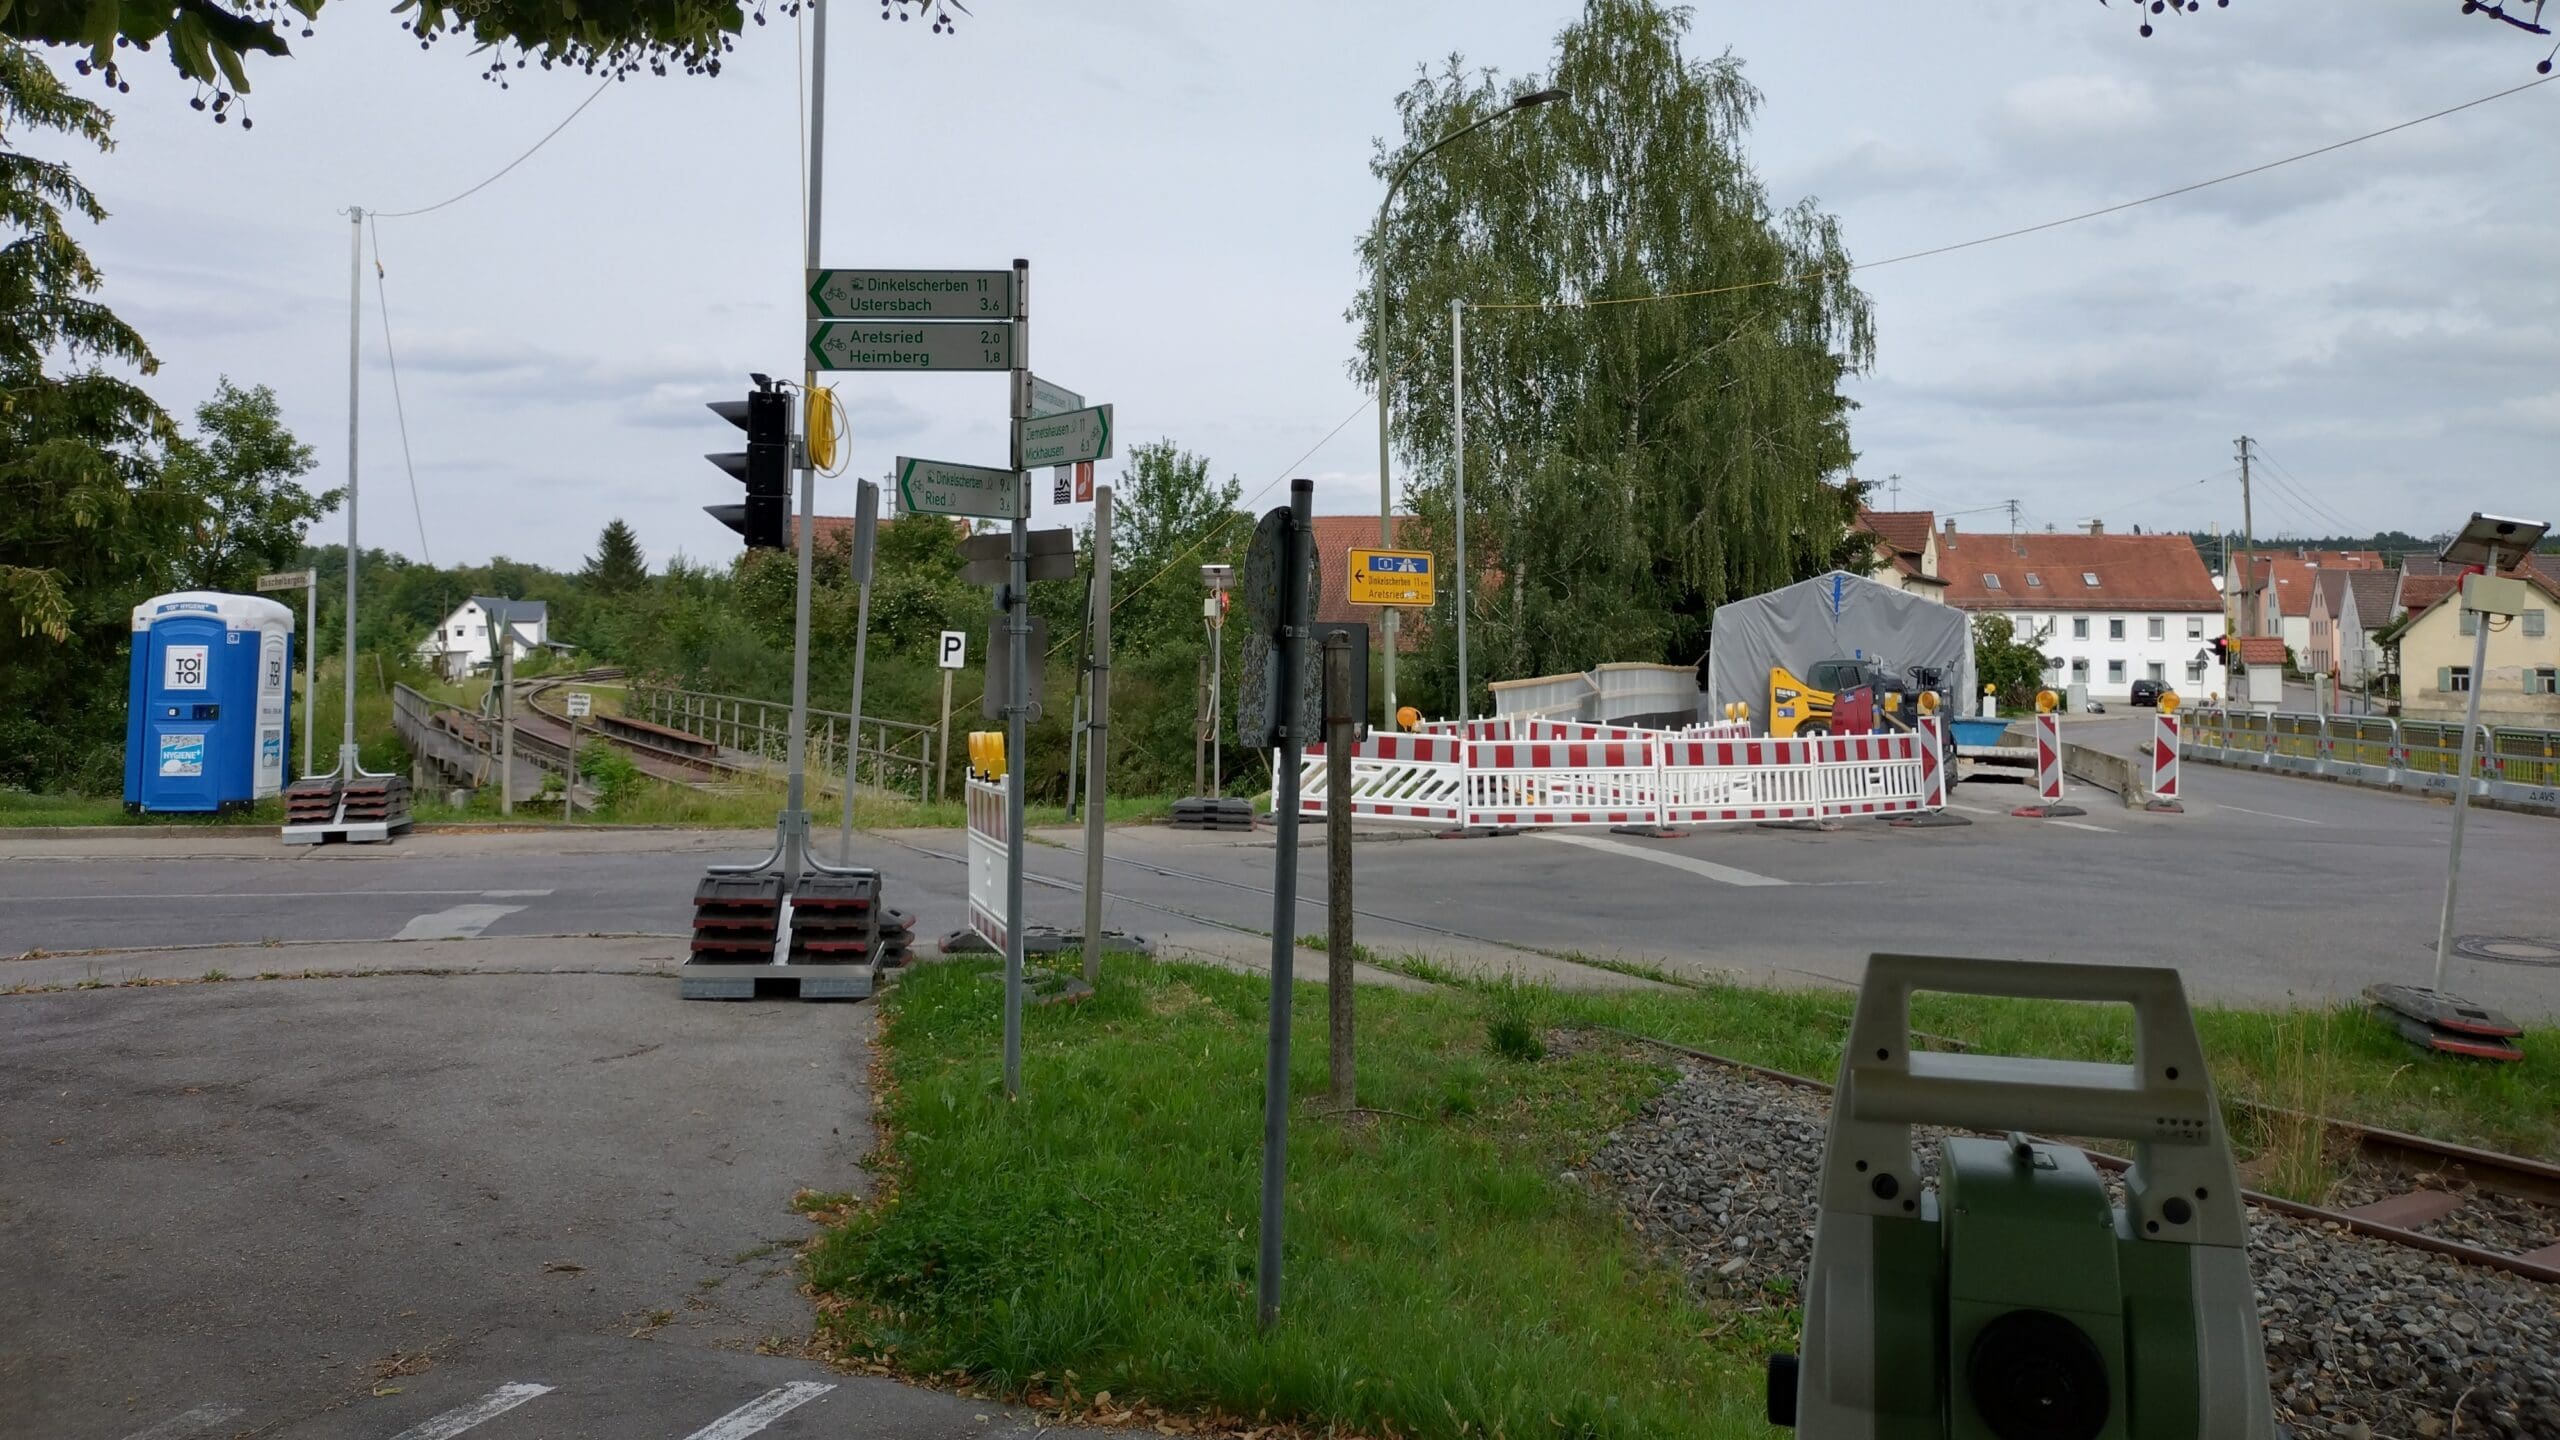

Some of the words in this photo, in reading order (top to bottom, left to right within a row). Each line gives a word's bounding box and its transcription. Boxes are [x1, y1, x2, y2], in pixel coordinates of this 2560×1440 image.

[868, 278, 969, 292] Dinkelscherben
[976, 278, 988, 292] 11
[850, 298, 932, 311] Ustersbach
[850, 330, 923, 344] Aretsried
[850, 349, 930, 366] Heimberg
[936, 470, 983, 489] Dinkelscherben
[925, 491, 946, 506] Ried
[1368, 590, 1404, 600] Aretsried
[944, 636, 962, 662] P
[175, 658, 202, 671] TOI
[175, 671, 201, 684] TOI
[2538, 792, 2555, 802] AVS
